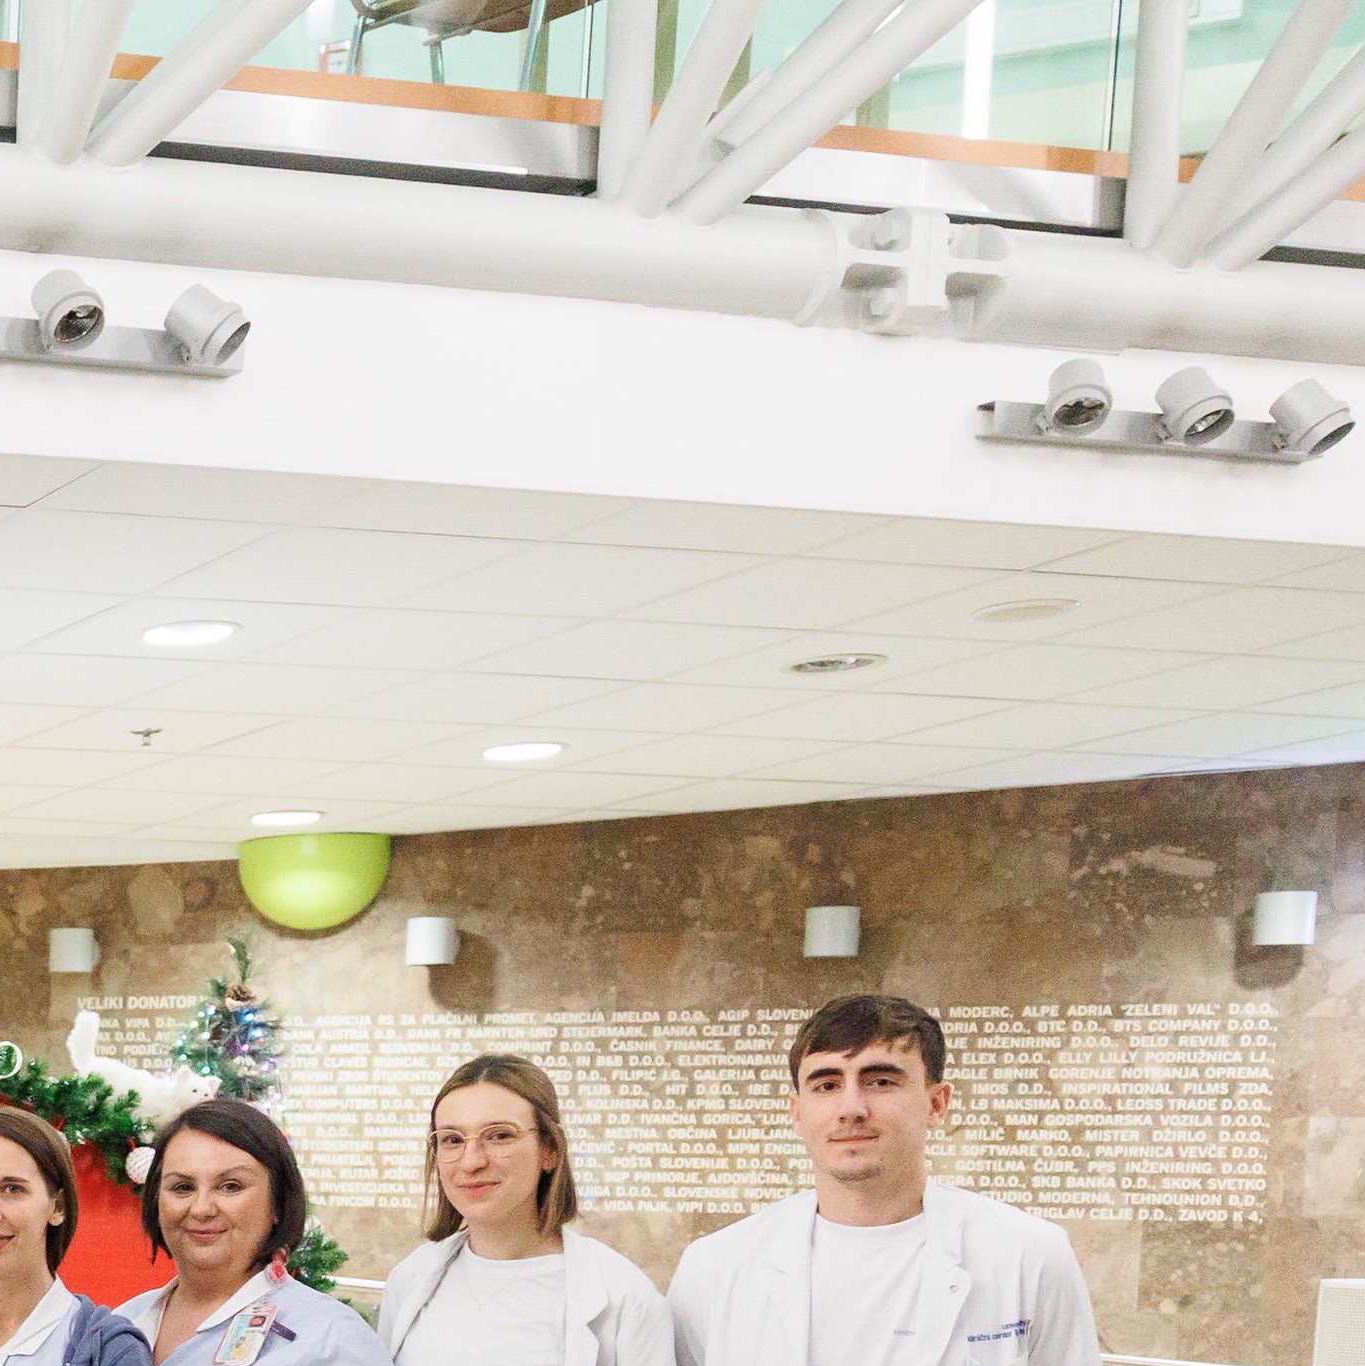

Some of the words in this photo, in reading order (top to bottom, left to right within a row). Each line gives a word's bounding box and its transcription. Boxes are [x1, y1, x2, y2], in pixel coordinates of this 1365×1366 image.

[77, 997, 123, 1009] VELIKI
[544, 1011, 605, 1023] AGENCIJA
[611, 1010, 660, 1022] IMELDA
[717, 1009, 750, 1021] AGIP
[948, 1006, 1013, 1020] MODERC,
[1021, 1005, 1059, 1018] ALPE
[1066, 1004, 1112, 1017] ADRIA
[652, 1025, 697, 1037] BANKA
[702, 1024, 741, 1036] CELJE
[983, 1021, 1031, 1035] D.O.O.,
[1037, 1021, 1066, 1033] BTC
[1072, 1020, 1106, 1034] D.D.,
[1113, 1020, 1141, 1032] BTS
[1148, 1019, 1220, 1032] COMPANY
[1227, 1018, 1277, 1033] D.O.O.,
[559, 1041, 601, 1054] D.O.O.,
[609, 1038, 656, 1052] ČASNIK
[665, 1040, 725, 1053] FINANCE,
[734, 1039, 774, 1051] DAIRY
[977, 1034, 1061, 1049] INŽENIRING
[1129, 1035, 1169, 1048] DELO
[1177, 1034, 1230, 1047] REVIJE
[1239, 1033, 1276, 1048] D.D.,
[961, 1053, 997, 1065] ELEX
[1058, 1052, 1092, 1064] ELLY
[1099, 1051, 1138, 1064] LILLY
[1144, 1048, 1242, 1063] PODRUŽNICA
[693, 1069, 756, 1081] GALERIJA
[942, 1068, 988, 1080] EAGLE
[1048, 1067, 1116, 1079] GORENJE
[1121, 1067, 1199, 1079] NOTRANJA
[1204, 1066, 1274, 1080] OPREMA,
[664, 1084, 687, 1096] HIT
[972, 1083, 1009, 1095] IMOS
[1017, 1083, 1051, 1097] D.D.,
[1062, 1082, 1173, 1095] INSPIRATIONAL
[1183, 1082, 1229, 1095] FILMS
[1238, 1081, 1273, 1096] ZDA,
[586, 1099, 649, 1110] KOLINSKA
[970, 1099, 988, 1110] LB
[992, 1099, 1060, 1110] MAKSIMA
[1116, 1098, 1163, 1110] LEOSS
[1167, 1098, 1217, 1110] TRADE
[640, 1111, 696, 1125] IVANČNA
[1004, 1114, 1038, 1127] MAN
[1044, 1114, 1152, 1127] GOSPODARSKA
[1160, 1114, 1213, 1127] VOZILA
[1219, 1114, 1270, 1129] D.O.O.,
[605, 1128, 656, 1140] MESTNA
[667, 1126, 717, 1140] OBČINA
[1016, 1129, 1072, 1143] MARKO,
[1082, 1129, 1139, 1142] MISTER
[1151, 1128, 1206, 1142] DŽIRLO
[1218, 1130, 1269, 1144] D.O.O.,
[627, 1142, 677, 1154] PORTAL
[727, 1143, 760, 1155] MPM
[961, 1145, 1038, 1157] SOFTWARE
[1042, 1145, 1089, 1159] D.O.O.,
[1095, 1145, 1174, 1158] PAPIRNICA
[1178, 1143, 1227, 1159] VEVČE
[1231, 1146, 1268, 1160] D.D.,
[612, 1155, 652, 1169] POŠTA
[659, 1157, 728, 1170] SLOVENIJE
[736, 1158, 780, 1172] D.O.O.,
[954, 1160, 1025, 1173] GOSTILNA
[1087, 1161, 1116, 1174] PPS
[1124, 1159, 1212, 1174] INŽENIRING
[707, 1171, 792, 1187] AJDOVŠČINA,
[978, 1176, 1026, 1190] D.O.O.,
[1030, 1176, 1060, 1189] SKB
[1065, 1177, 1115, 1189] BANKA
[1161, 1177, 1202, 1191] SKOK
[1206, 1178, 1266, 1191] SVETKO
[663, 1186, 738, 1199] SLOVENSKE
[1038, 1191, 1114, 1206] MODERNA,
[1122, 1192, 1222, 1206] TEHNOUNION
[605, 1199, 636, 1212] VIDA
[676, 1201, 702, 1213] VIPI
[1089, 1207, 1133, 1220] CELJE
[1177, 1208, 1228, 1222] ZAVOD
[1231, 1209, 1243, 1222] K
[1246, 1210, 1263, 1224] 4,
